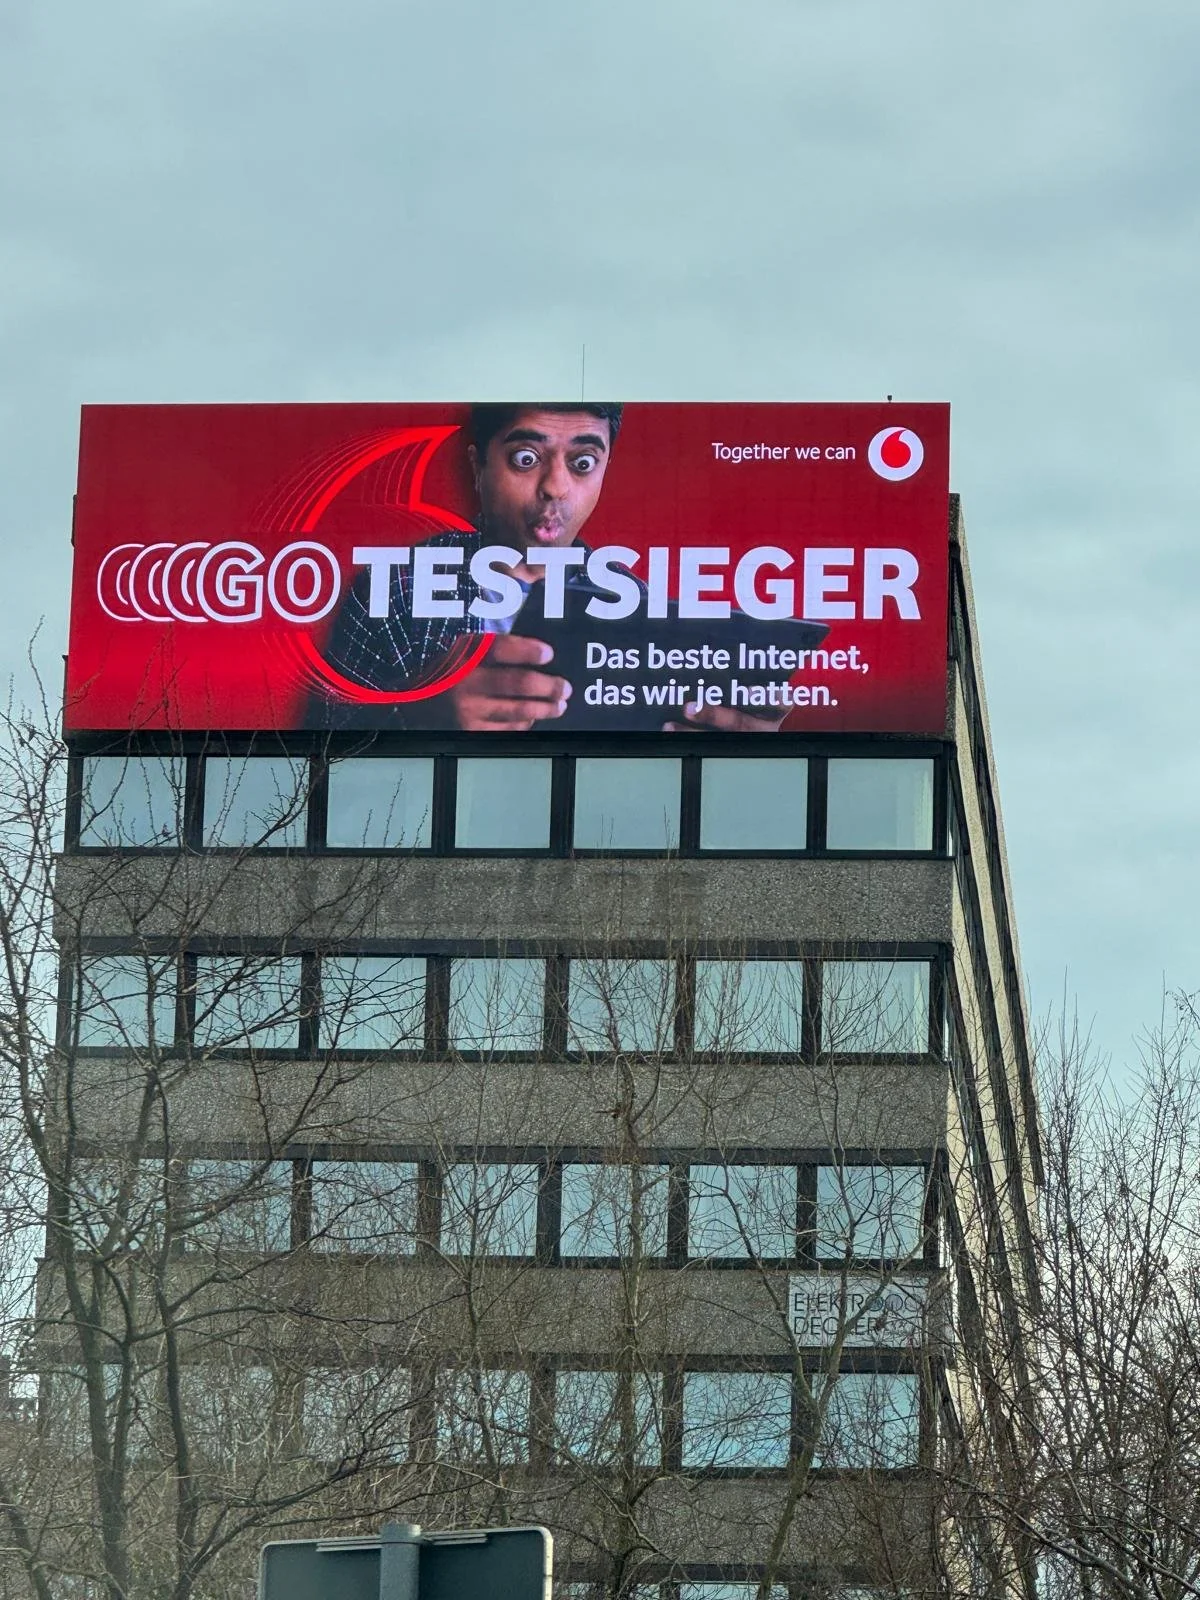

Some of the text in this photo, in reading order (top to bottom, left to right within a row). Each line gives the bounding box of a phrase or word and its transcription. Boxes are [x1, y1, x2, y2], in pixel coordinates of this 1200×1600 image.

[711, 442, 856, 464] Together we can
[352, 545, 922, 620] TESTSIEGER
[586, 642, 869, 675] Das beste Internet,
[584, 678, 838, 714] das wir je hatten.
[793, 1316, 880, 1336] DECER
